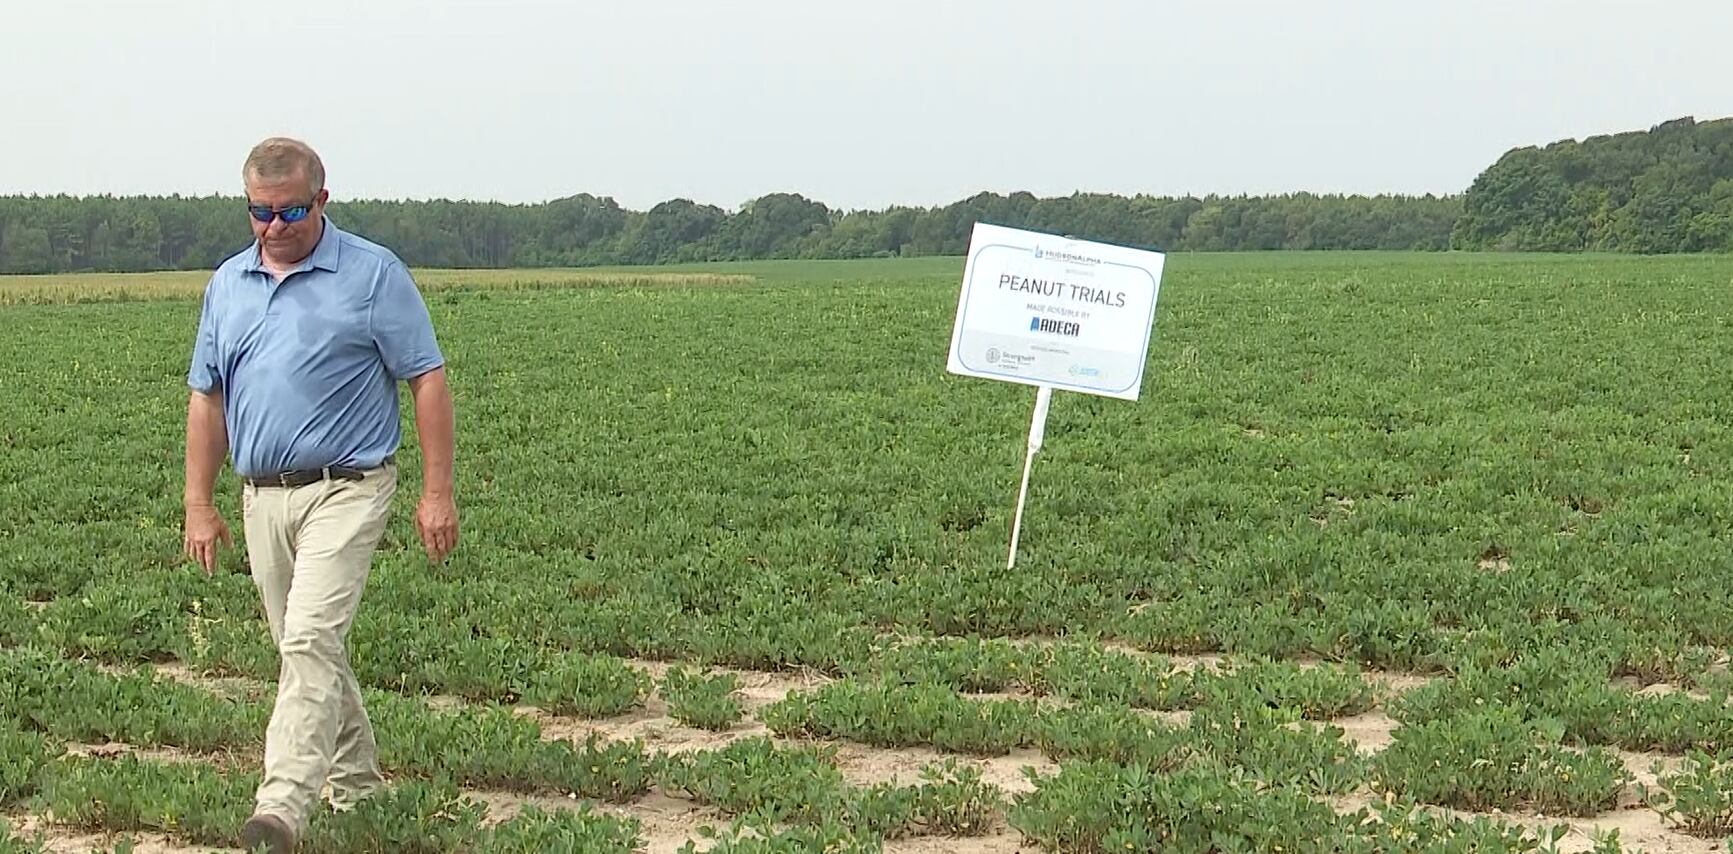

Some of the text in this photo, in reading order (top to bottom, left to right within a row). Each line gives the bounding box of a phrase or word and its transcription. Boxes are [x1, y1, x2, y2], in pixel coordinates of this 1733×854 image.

[999, 273, 1126, 308] PEANUT TRIALS
[1026, 303, 1046, 314] MADE
[1040, 318, 1080, 337] ADECA
